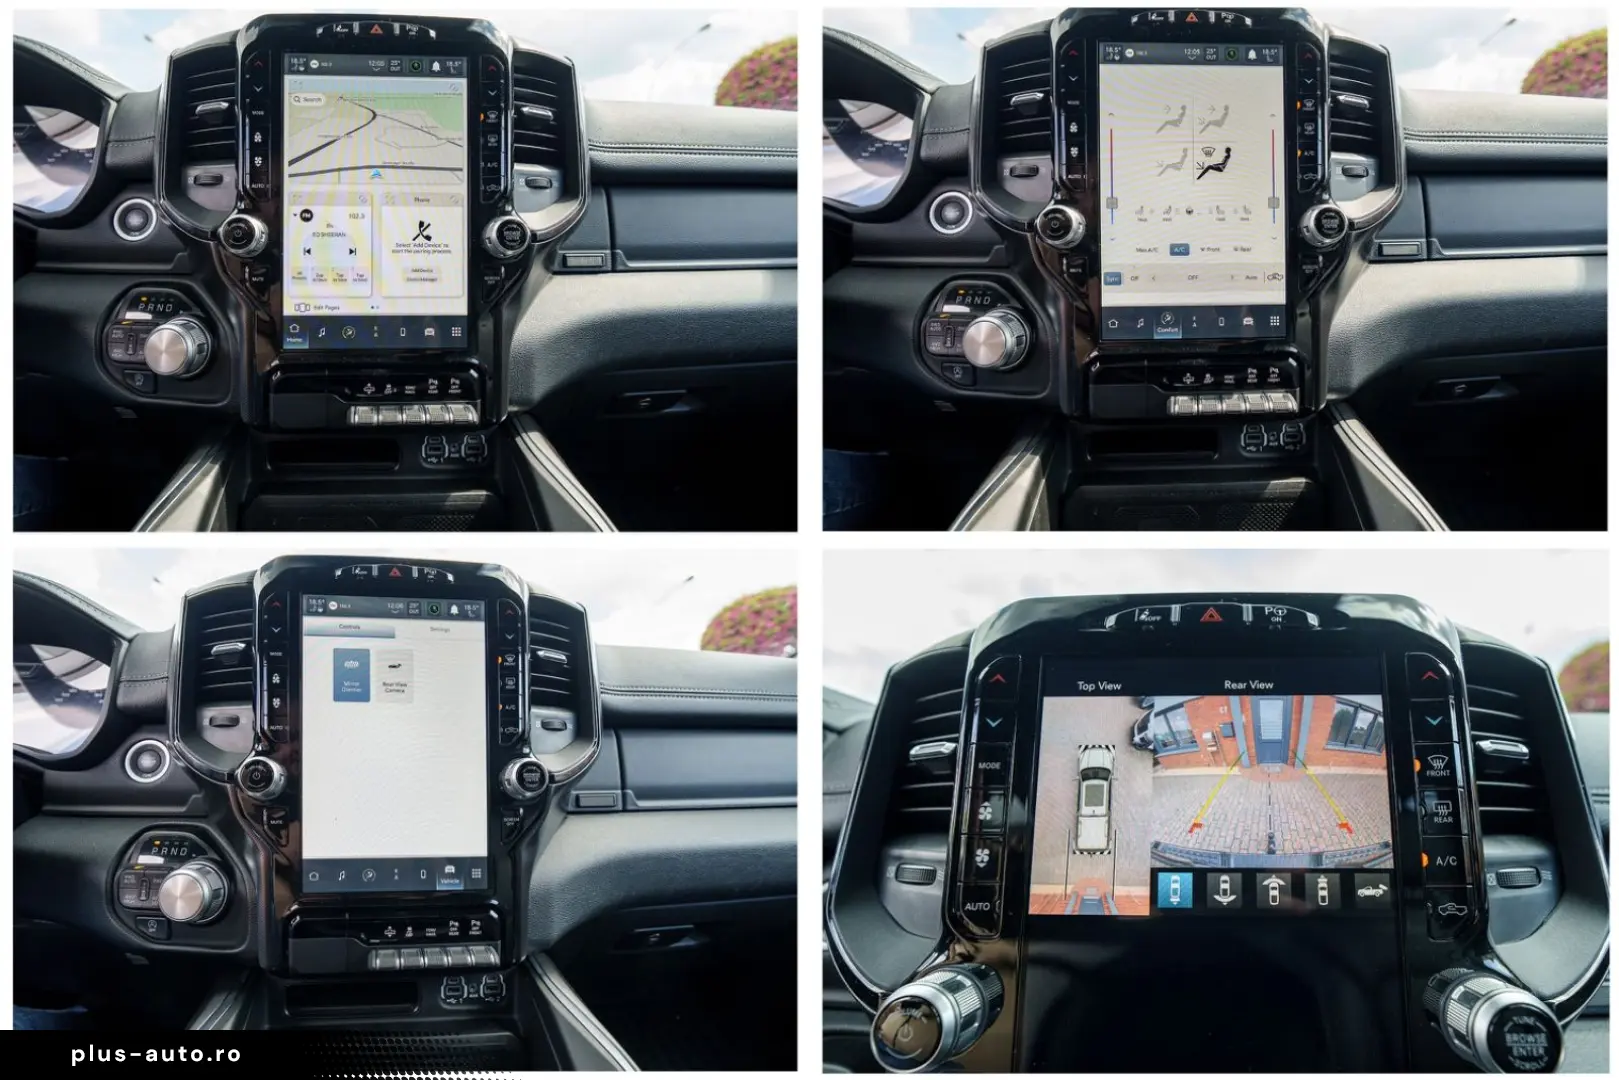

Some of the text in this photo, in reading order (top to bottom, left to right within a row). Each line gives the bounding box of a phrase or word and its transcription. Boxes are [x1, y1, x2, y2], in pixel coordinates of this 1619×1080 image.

[1077, 681, 1122, 691] Top View
[1224, 680, 1274, 690] Rear View
[1436, 856, 1457, 866] A/C
[964, 902, 990, 911] AUTO
[1512, 1015, 1536, 1026] TUNE
[1505, 1033, 1547, 1044] BROWSE
[1512, 1046, 1545, 1057] ENTER
